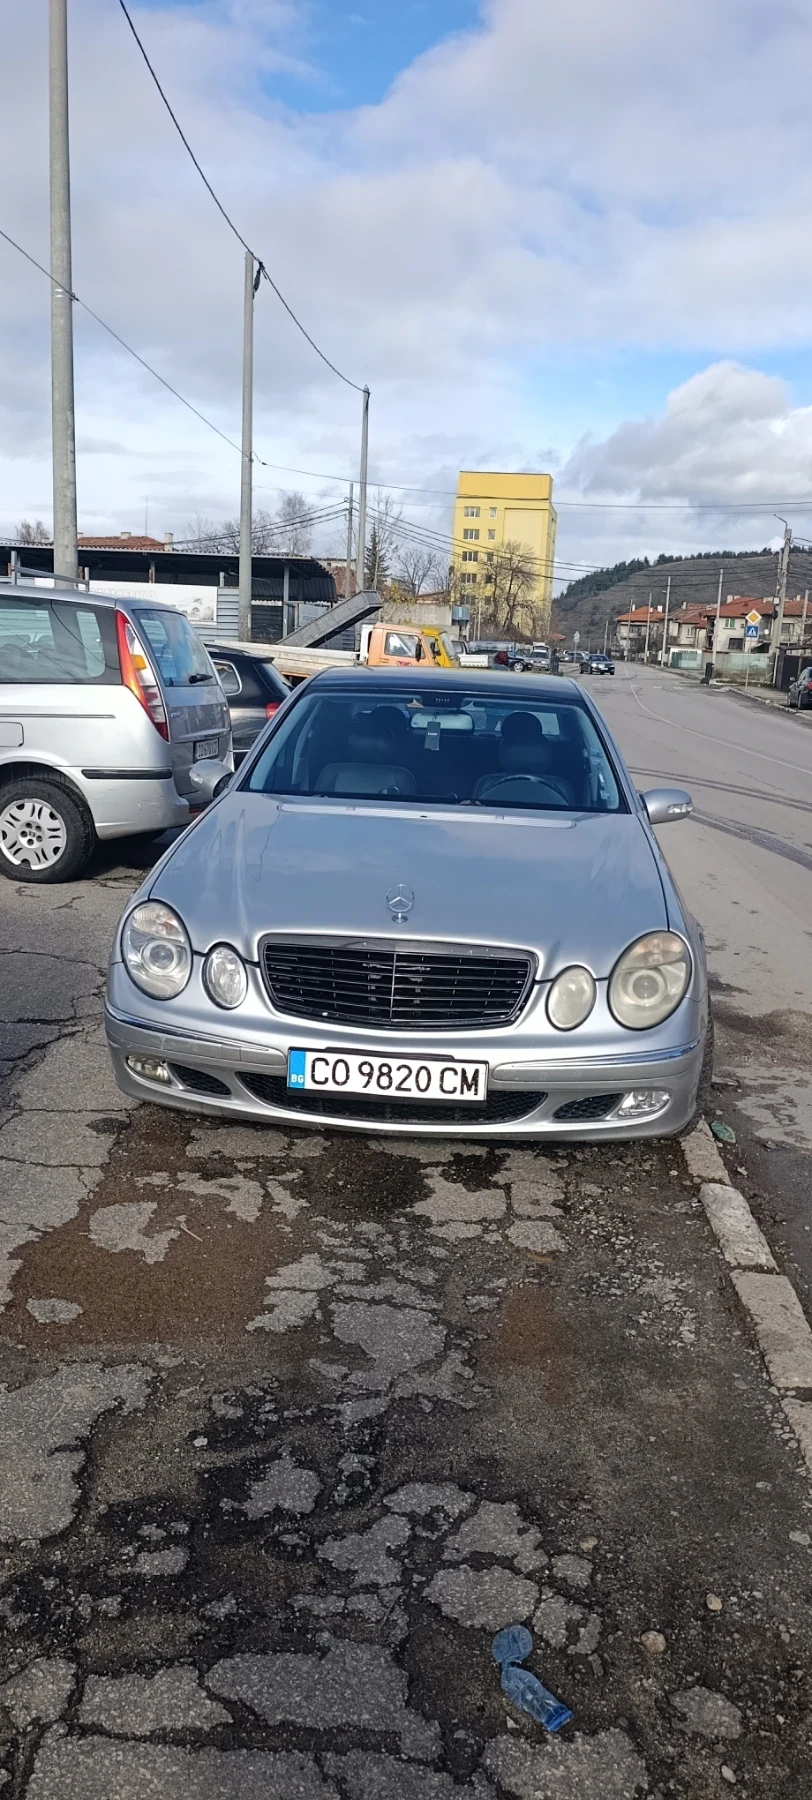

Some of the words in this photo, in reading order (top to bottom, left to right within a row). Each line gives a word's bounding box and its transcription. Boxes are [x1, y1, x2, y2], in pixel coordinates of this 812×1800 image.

[290, 1073, 305, 1084] BG
[310, 1057, 351, 1086] CO
[357, 1061, 432, 1093] 9820
[439, 1066, 480, 1096] CM
